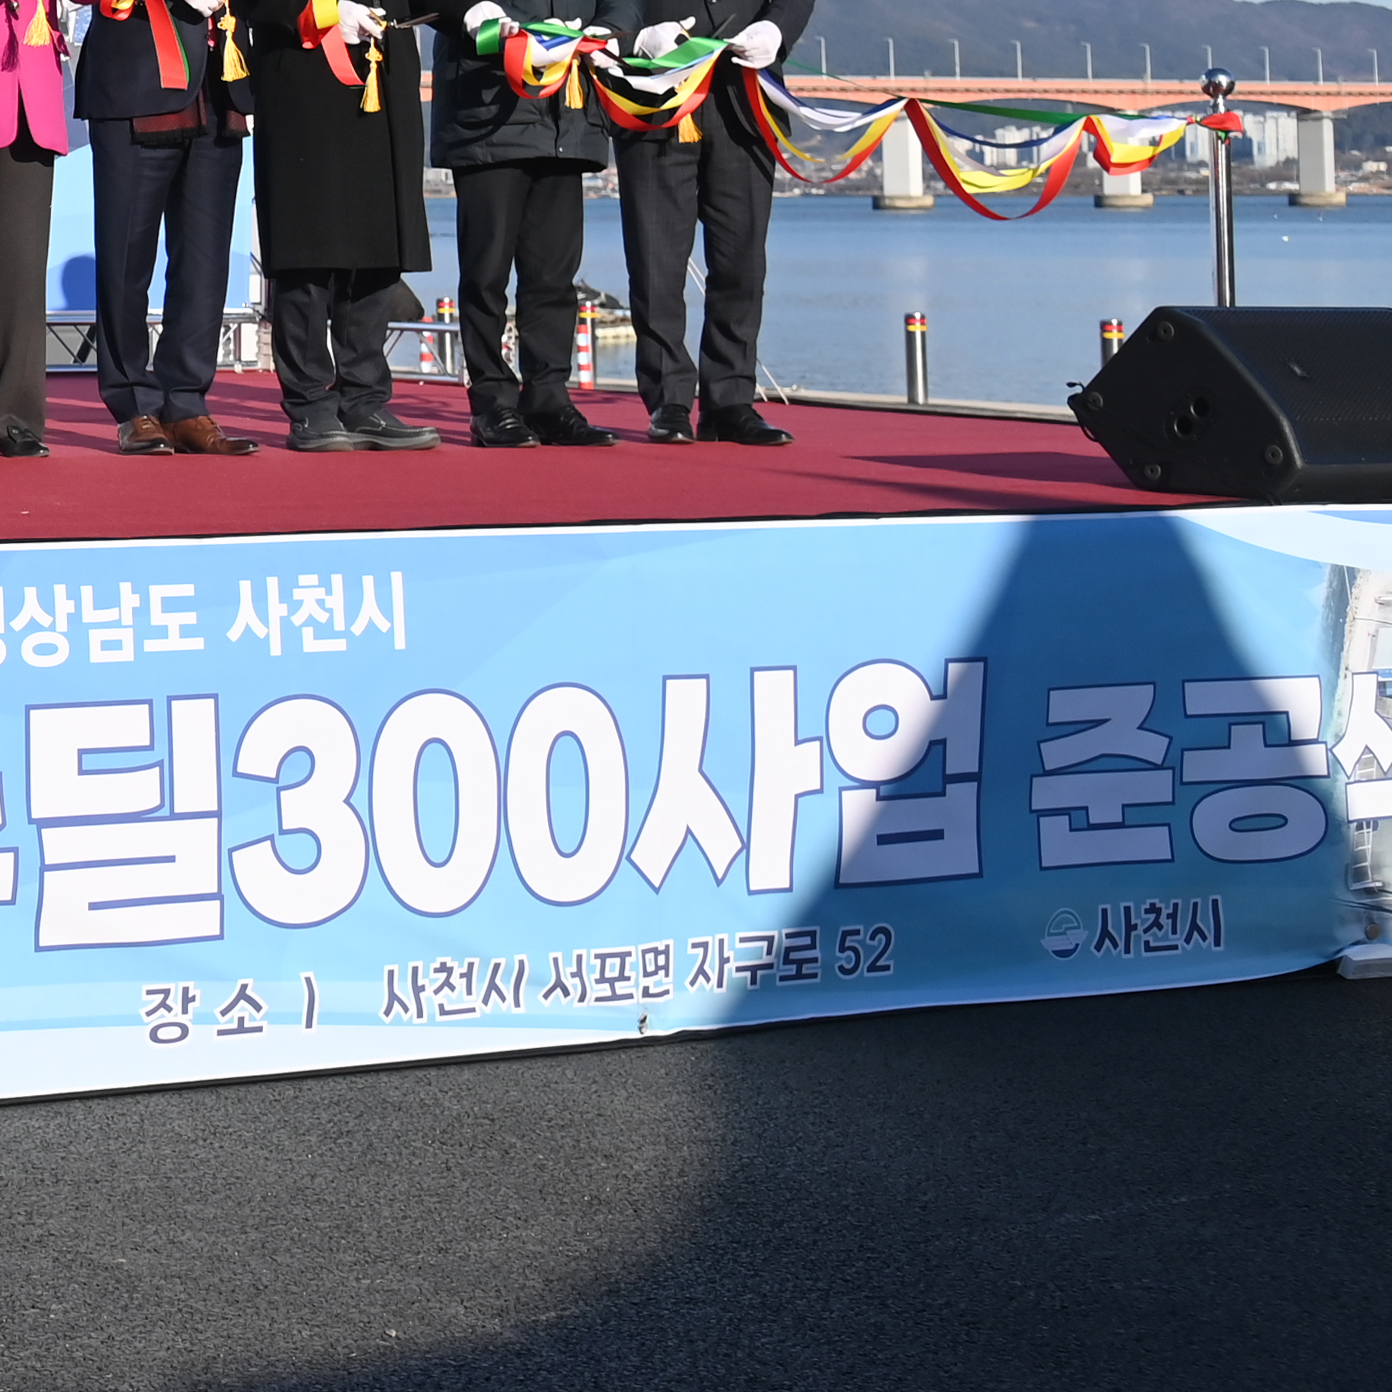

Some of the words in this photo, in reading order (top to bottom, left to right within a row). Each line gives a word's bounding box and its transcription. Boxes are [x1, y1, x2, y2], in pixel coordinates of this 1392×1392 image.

[225, 570, 407, 657] 사천시
[1091, 894, 1225, 958] 사천시
[380, 954, 526, 1025] 사천시
[541, 940, 675, 1008] 서포면
[685, 929, 821, 996] 자구로
[833, 924, 896, 978] 52
